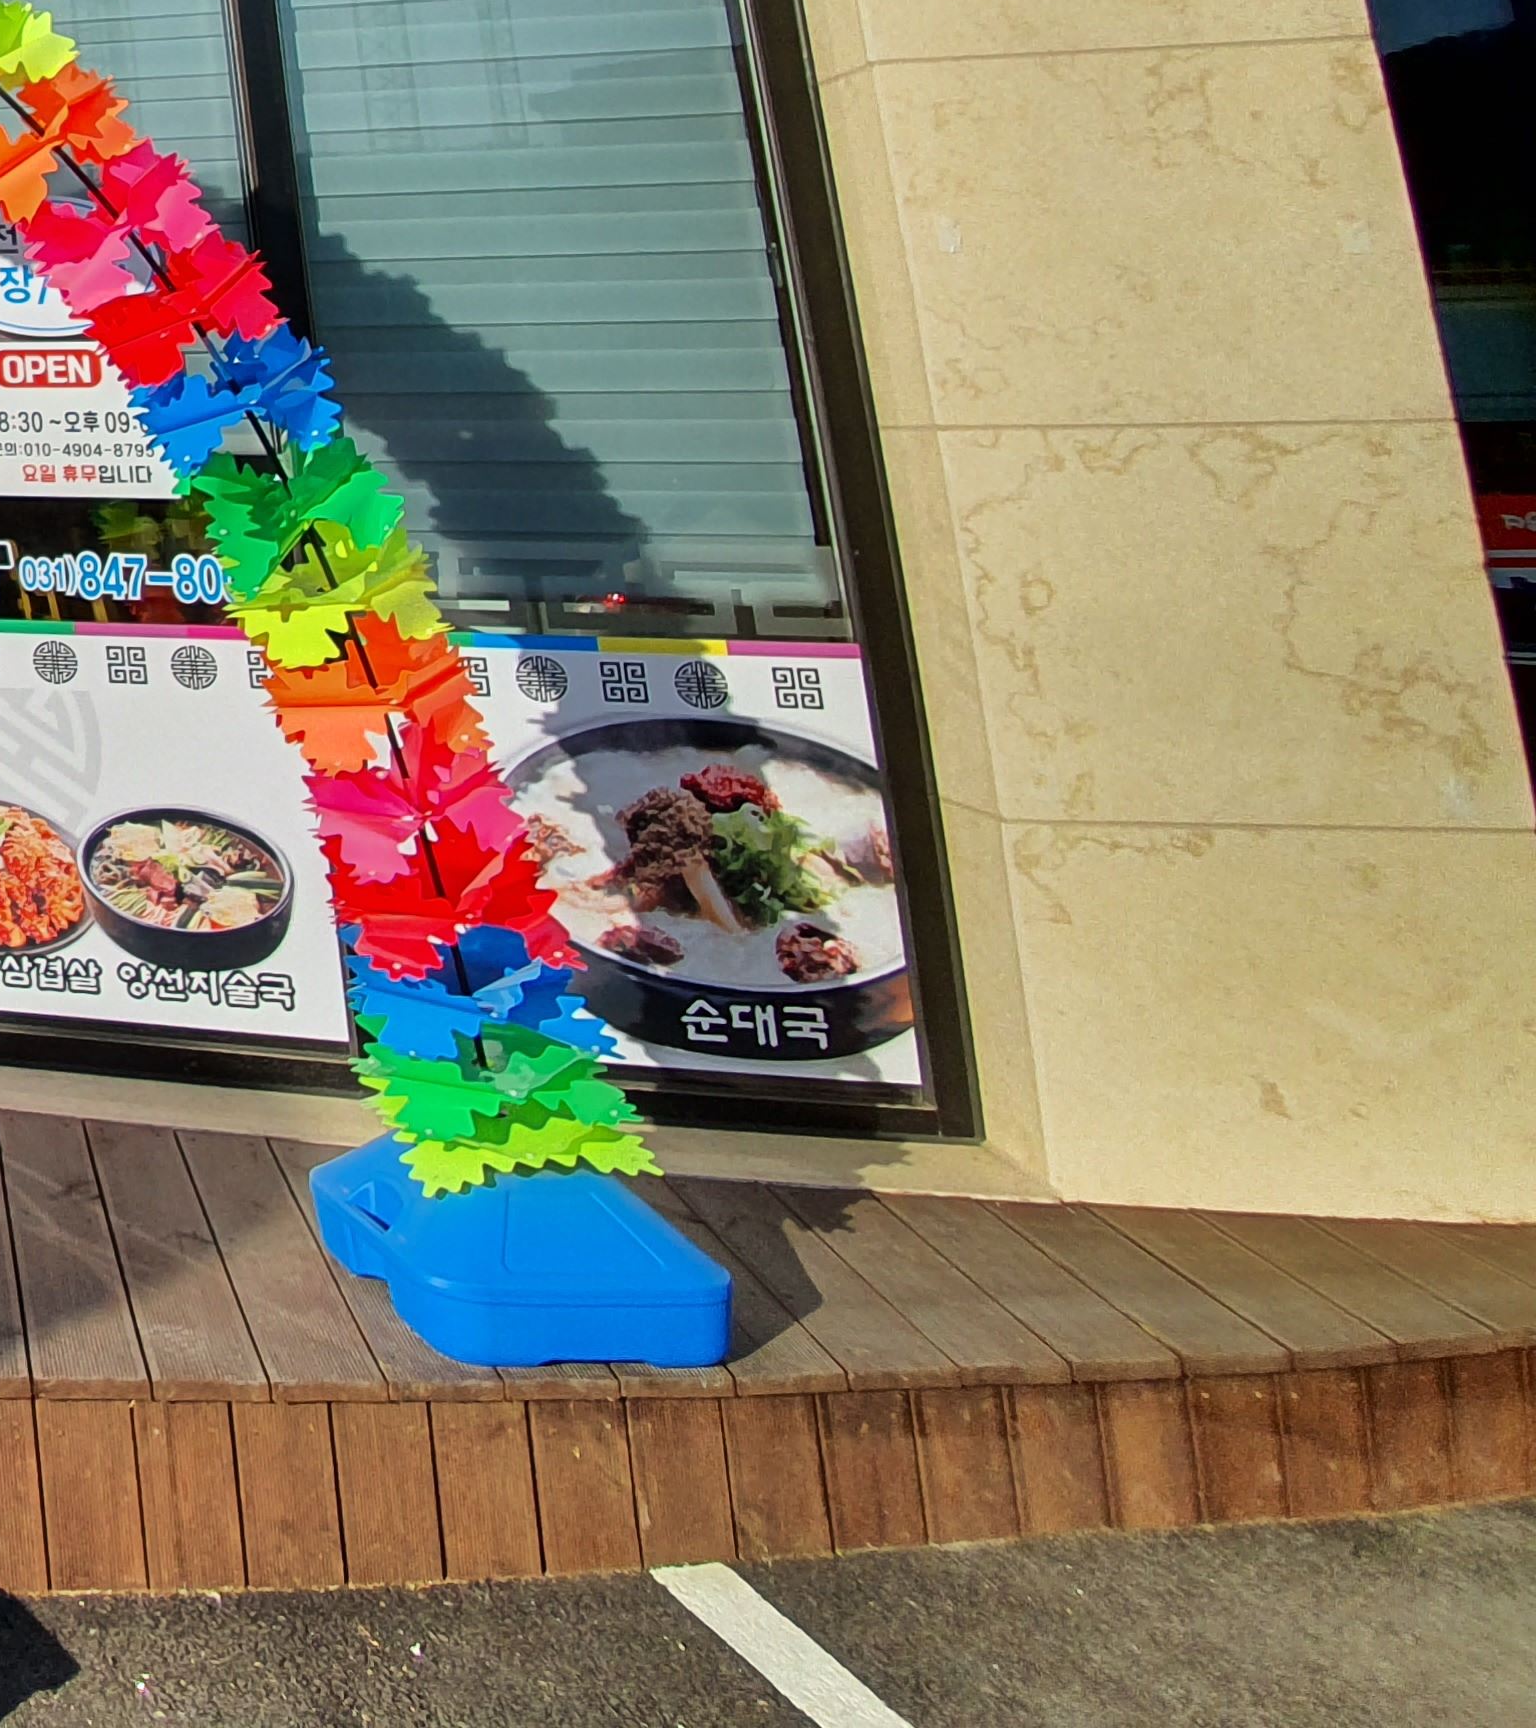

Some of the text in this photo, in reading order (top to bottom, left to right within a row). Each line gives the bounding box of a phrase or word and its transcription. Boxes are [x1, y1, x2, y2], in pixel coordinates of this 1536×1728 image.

[2, 354, 93, 385] OPEN
[105, 411, 148, 433] 09:
[22, 465, 57, 483] 요일
[62, 465, 153, 484] 휴무입니다
[19, 553, 234, 605] 031)847-80
[117, 962, 295, 1011] 양선지술국
[680, 999, 829, 1051] 순대국
